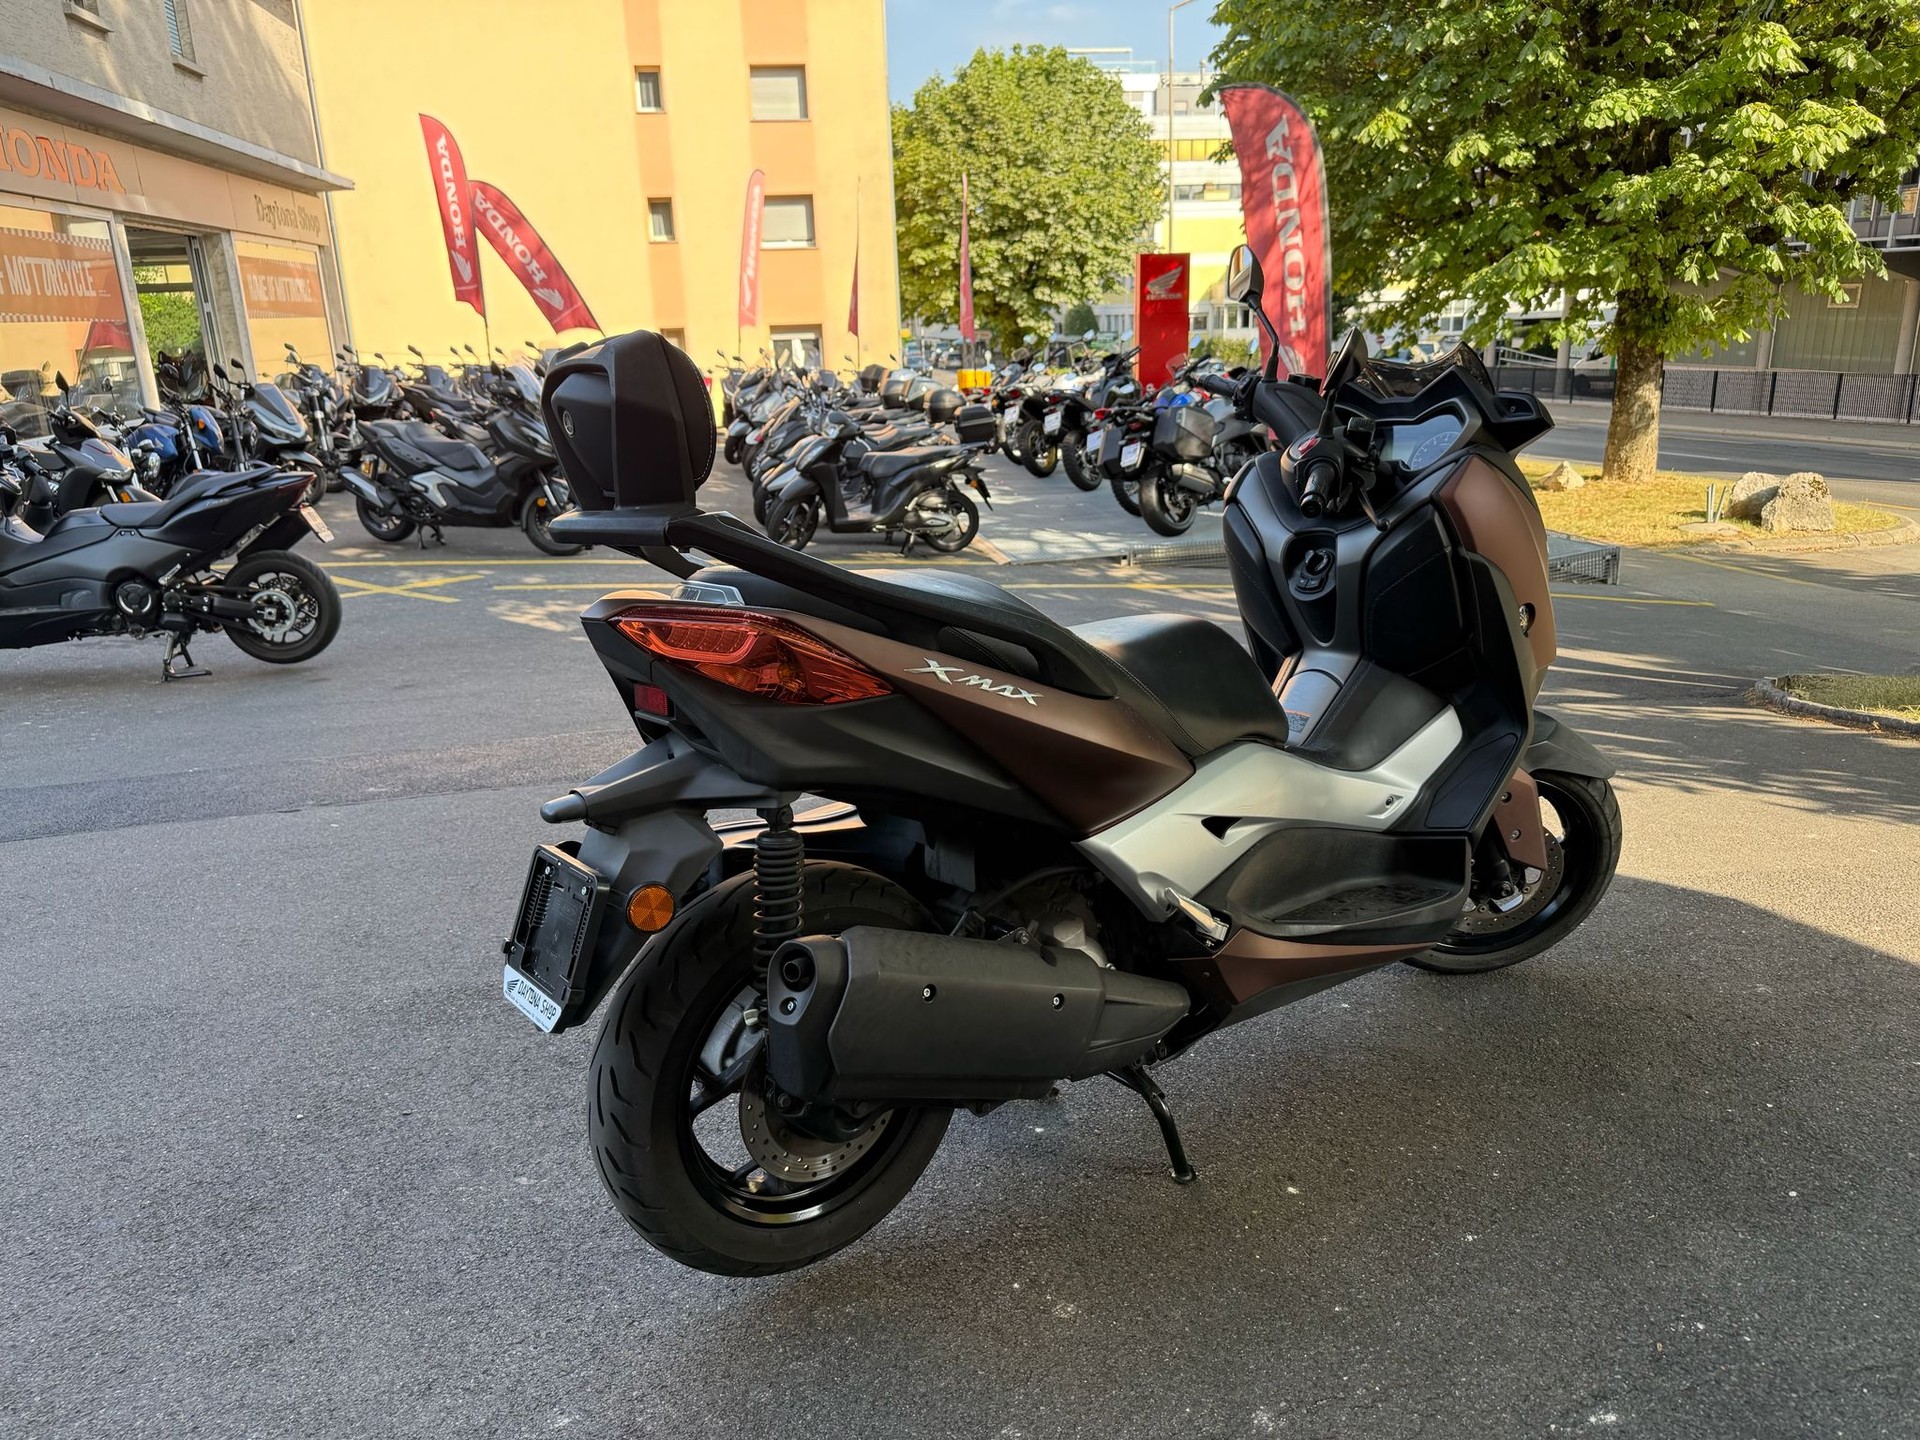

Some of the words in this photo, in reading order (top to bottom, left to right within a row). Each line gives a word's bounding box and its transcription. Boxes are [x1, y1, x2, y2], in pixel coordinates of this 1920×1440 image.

[436, 134, 467, 249] HONDA
[475, 188, 548, 284] HONDA
[1265, 114, 1307, 336] HONDA
[517, 980, 541, 1010] DAYTONA
[540, 999, 557, 1020] SHOP
